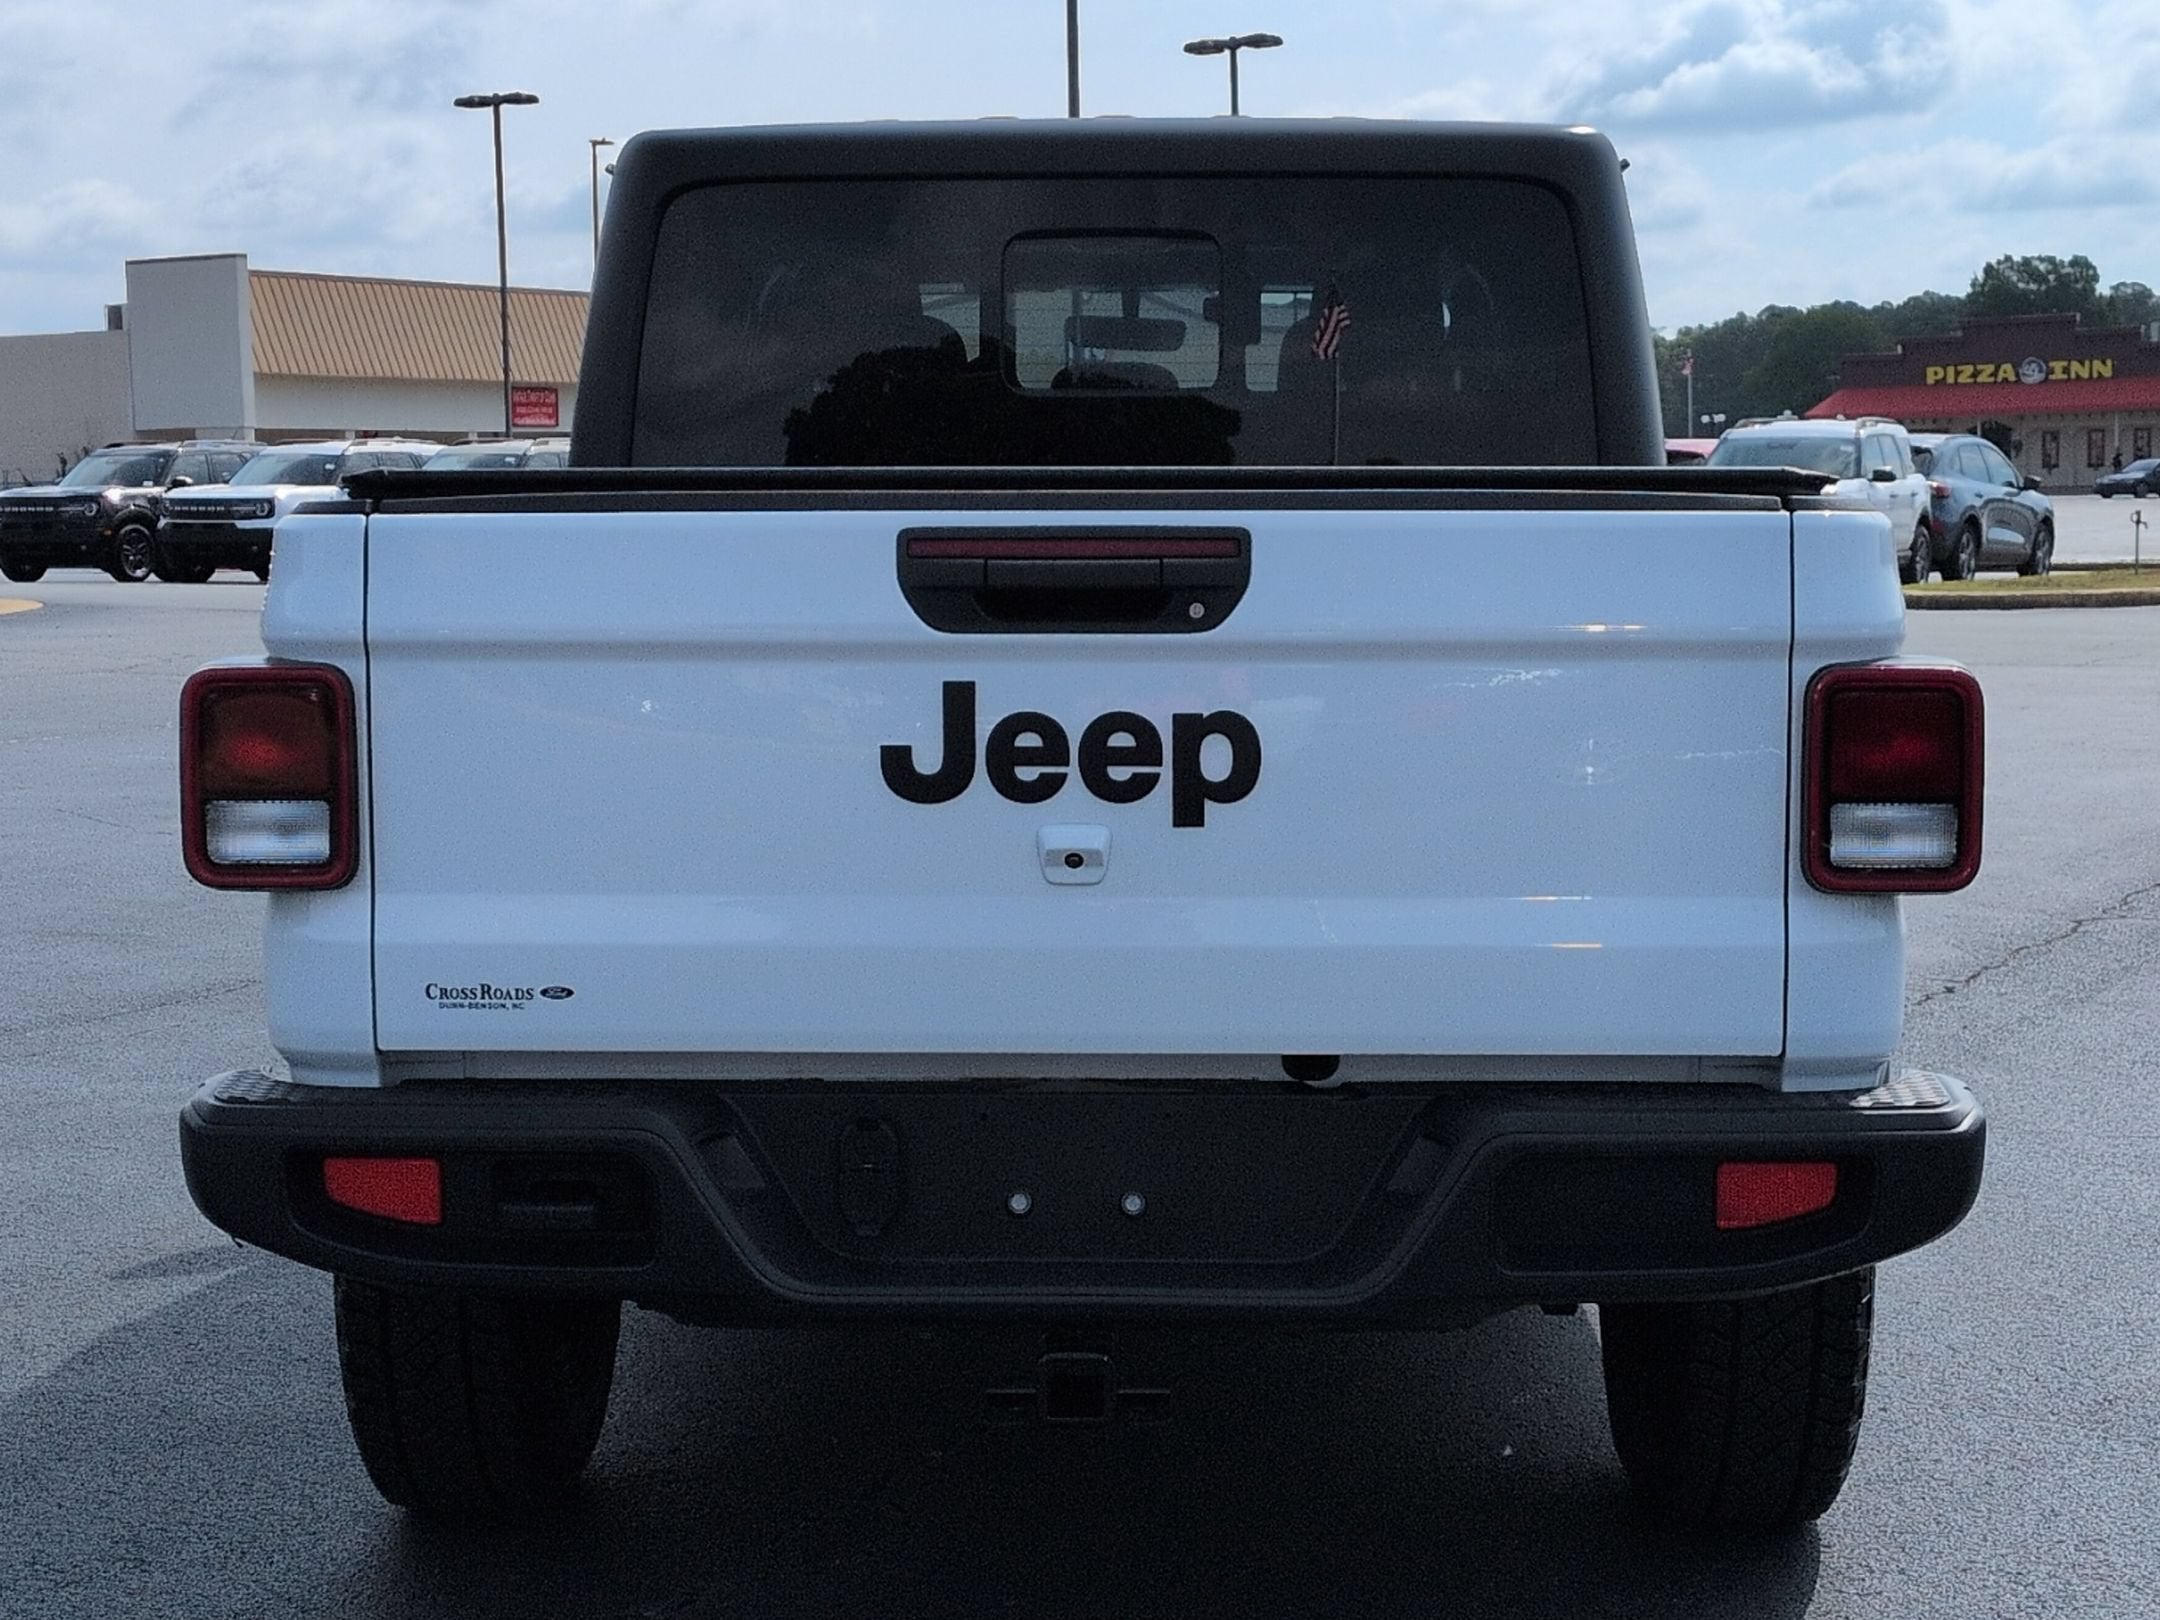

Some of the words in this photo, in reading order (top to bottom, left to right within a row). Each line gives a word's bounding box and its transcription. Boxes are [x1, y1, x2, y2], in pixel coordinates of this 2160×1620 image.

[1925, 362, 2018, 386] PIZZA
[2048, 358, 2113, 381] INN
[880, 681, 1262, 828] Jeep
